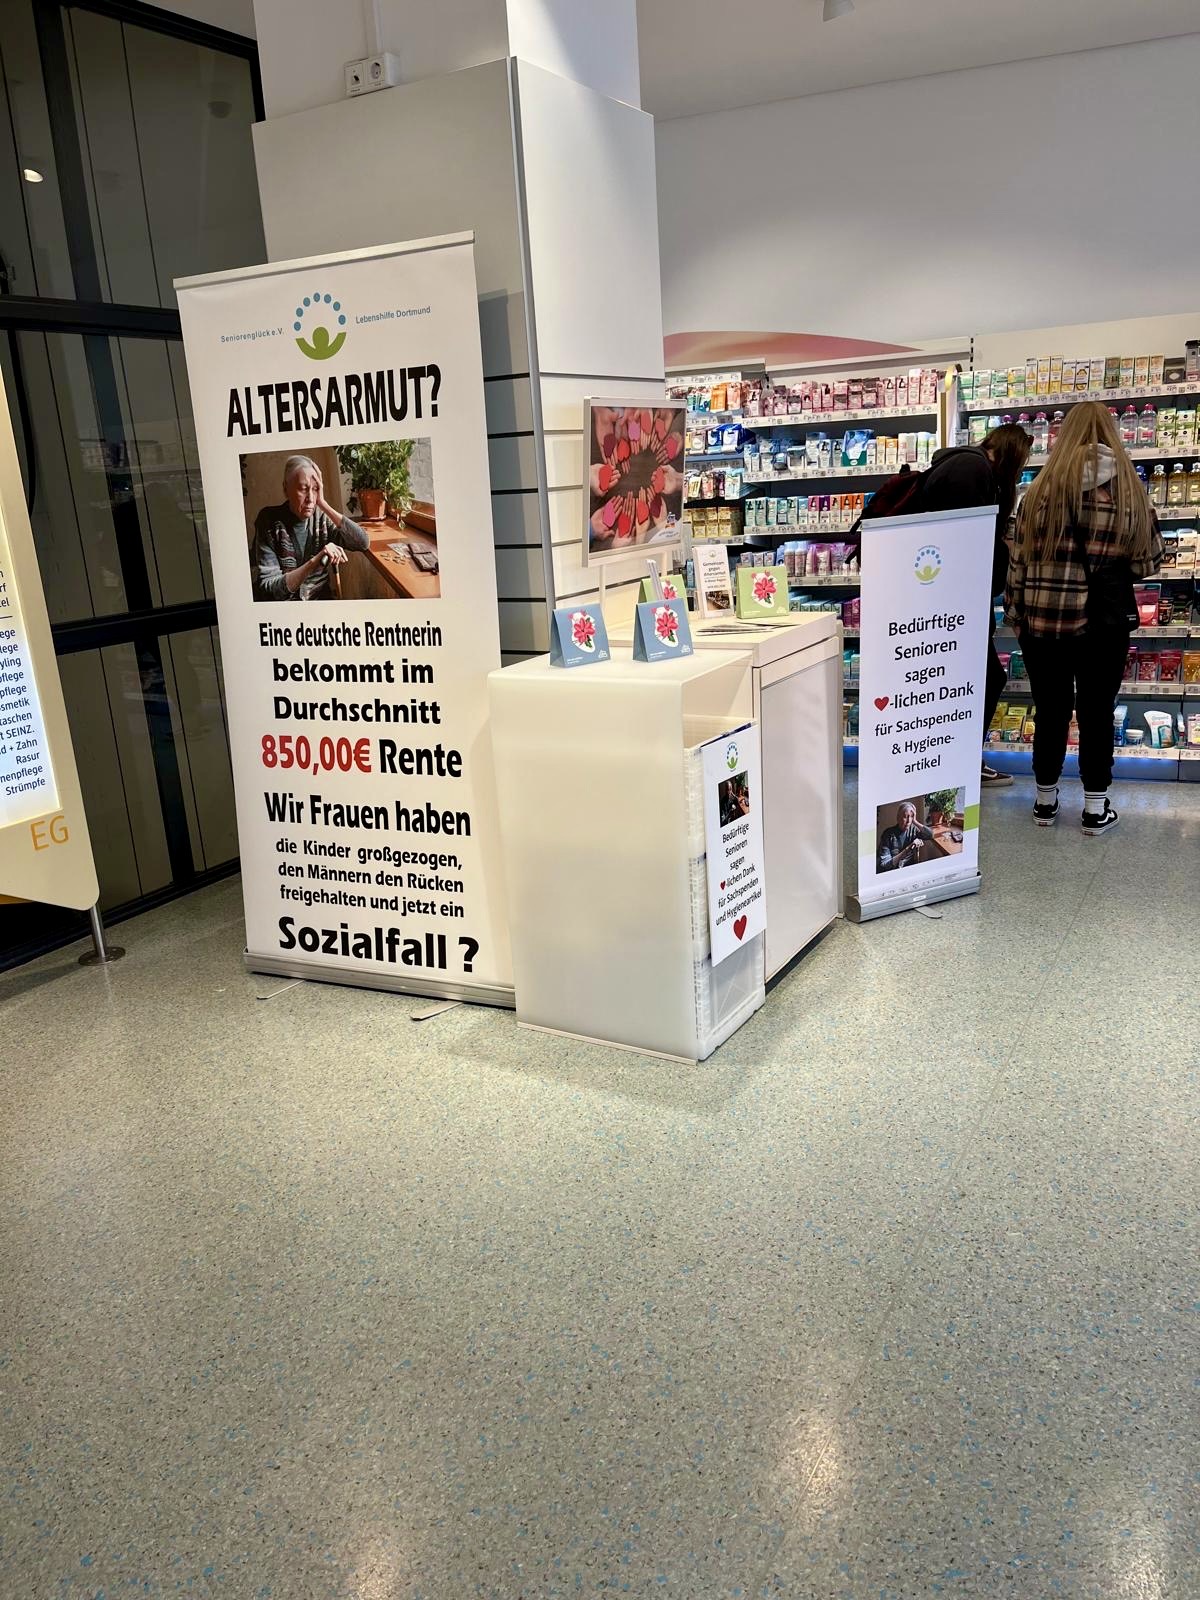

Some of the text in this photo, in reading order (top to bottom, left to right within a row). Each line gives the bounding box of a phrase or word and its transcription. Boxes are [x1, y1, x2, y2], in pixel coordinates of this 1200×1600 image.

[356, 306, 431, 324] Lebenshilfe Dortmund
[221, 328, 284, 343] Seniorenglück e.V.
[227, 364, 442, 437] ALTERSARMUT?
[259, 621, 442, 647] Eine deutsche Rentnerin
[889, 613, 965, 638] Bedürftige
[895, 638, 957, 661] Senioren
[273, 659, 434, 683] bekommt im
[905, 664, 945, 684] sagen
[939, 682, 974, 704] Dank
[274, 697, 441, 725] Durchschnitt
[875, 708, 972, 737] für Sachspenden
[6, 725, 35, 739] SEINZ.
[16, 739, 38, 750] Zahn
[262, 735, 462, 777] 850,00€ Rente
[892, 734, 955, 755] & Hygiene-
[16, 752, 40, 764] Rasur
[904, 755, 941, 774] artikel
[6, 778, 46, 795] Strümpfe
[264, 792, 471, 836] Wir Frauen haben
[30, 815, 69, 850] EG
[722, 823, 749, 843] Bedürftige
[276, 839, 462, 870] die Kinder großgezogen,
[725, 839, 747, 857] Senioren
[730, 856, 745, 870] sagen
[743, 864, 755, 878] Dank
[279, 862, 464, 893] den Männern den Rücken
[280, 885, 464, 917] freigehalten und jetzt ein
[718, 877, 758, 909] für Sachspenden
[716, 888, 762, 926] und Hygieneartikel
[279, 917, 480, 972] Sozialfall ?
